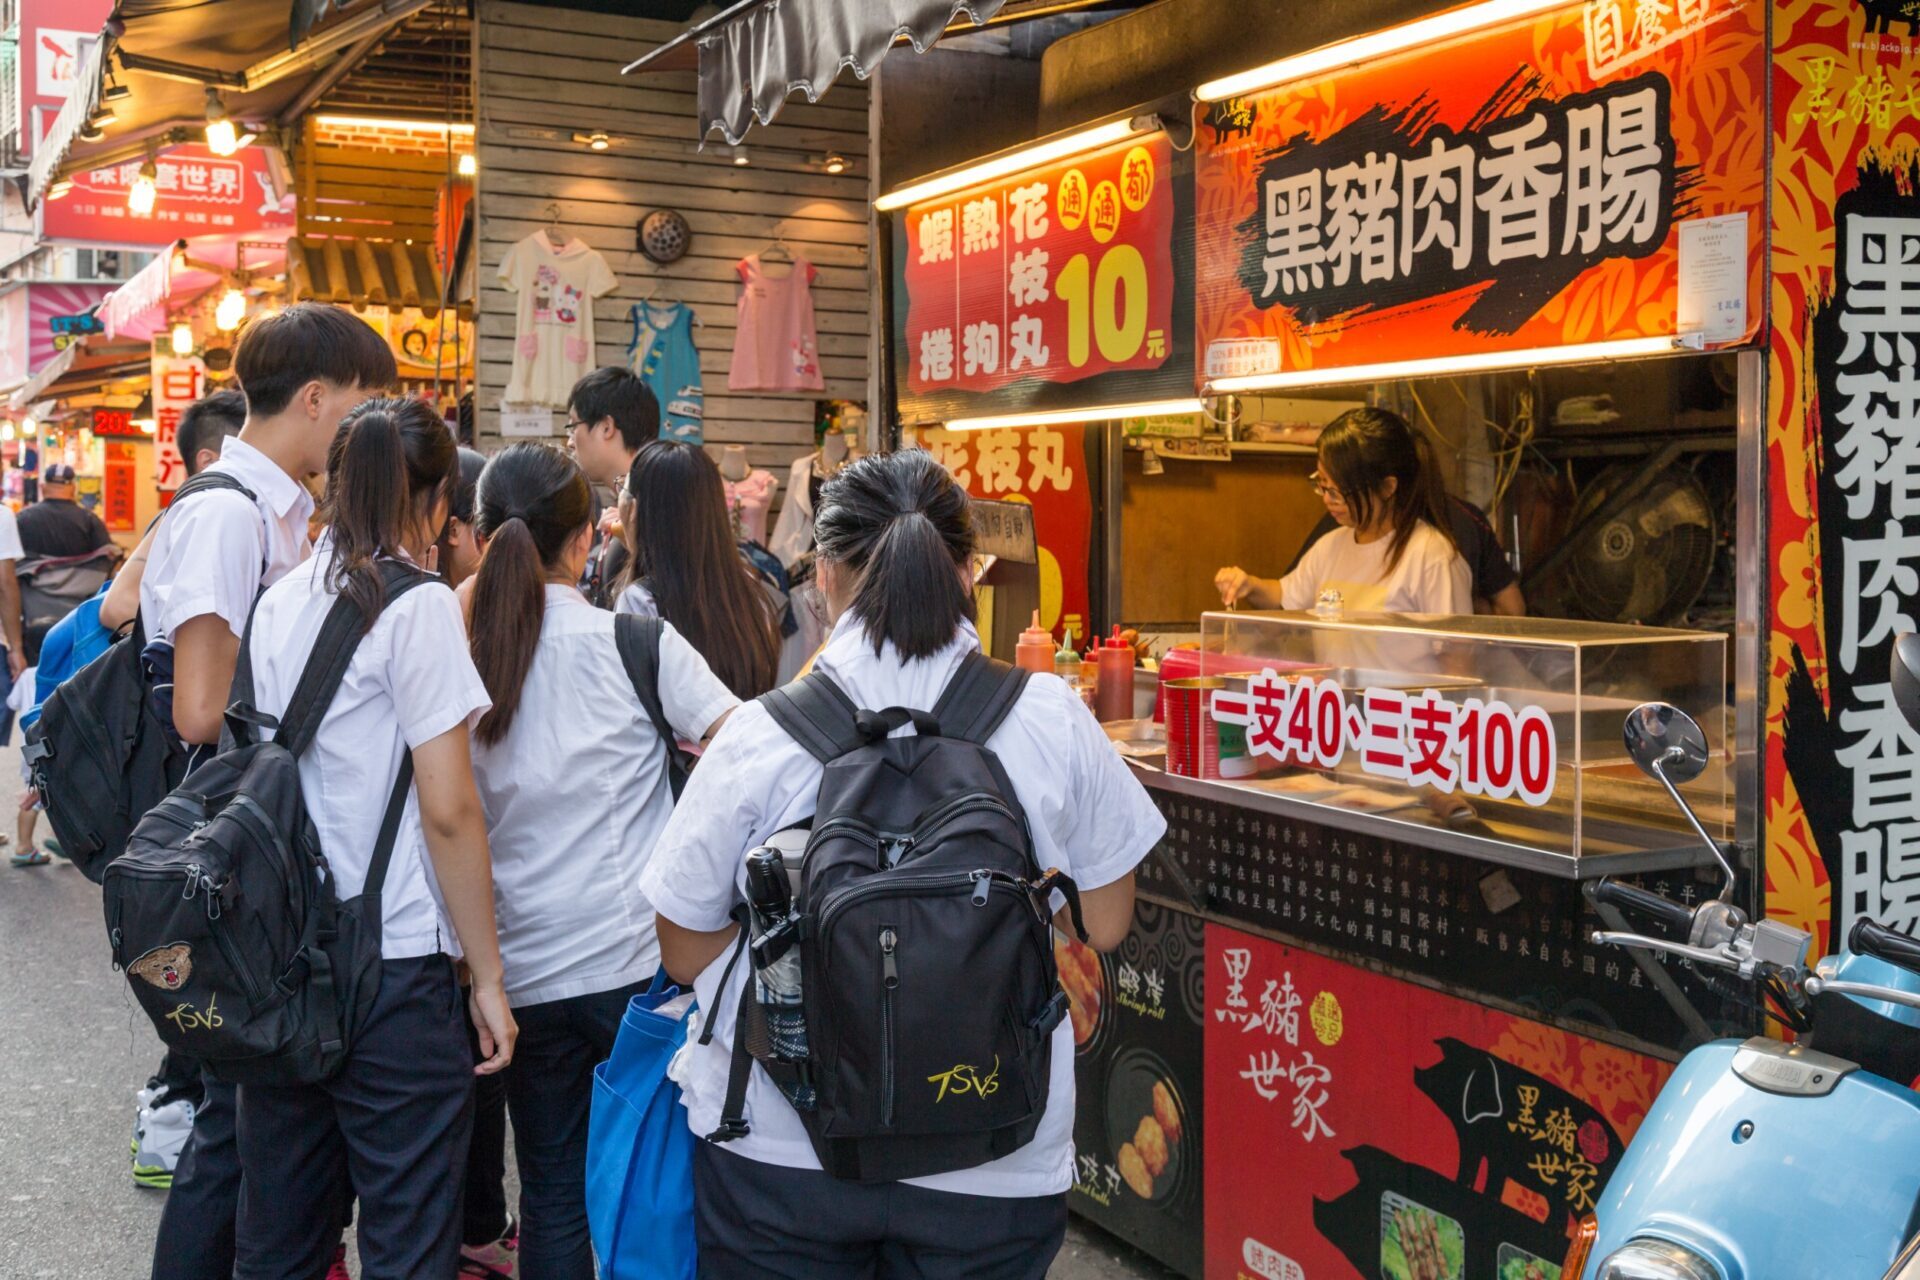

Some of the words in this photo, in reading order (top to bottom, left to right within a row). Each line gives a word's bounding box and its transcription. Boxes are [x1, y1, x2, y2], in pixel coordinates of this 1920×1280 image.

[1260, 87, 1662, 299] 黑豬肉香腸
[962, 196, 1001, 377] 熱狗
[1009, 181, 1050, 371] 花枝丸
[1215, 947, 1303, 1047] 黑豬
[1239, 1050, 1337, 1143] 世家
[1507, 1084, 1579, 1155] 黑豬
[1527, 1150, 1599, 1212] 世家
